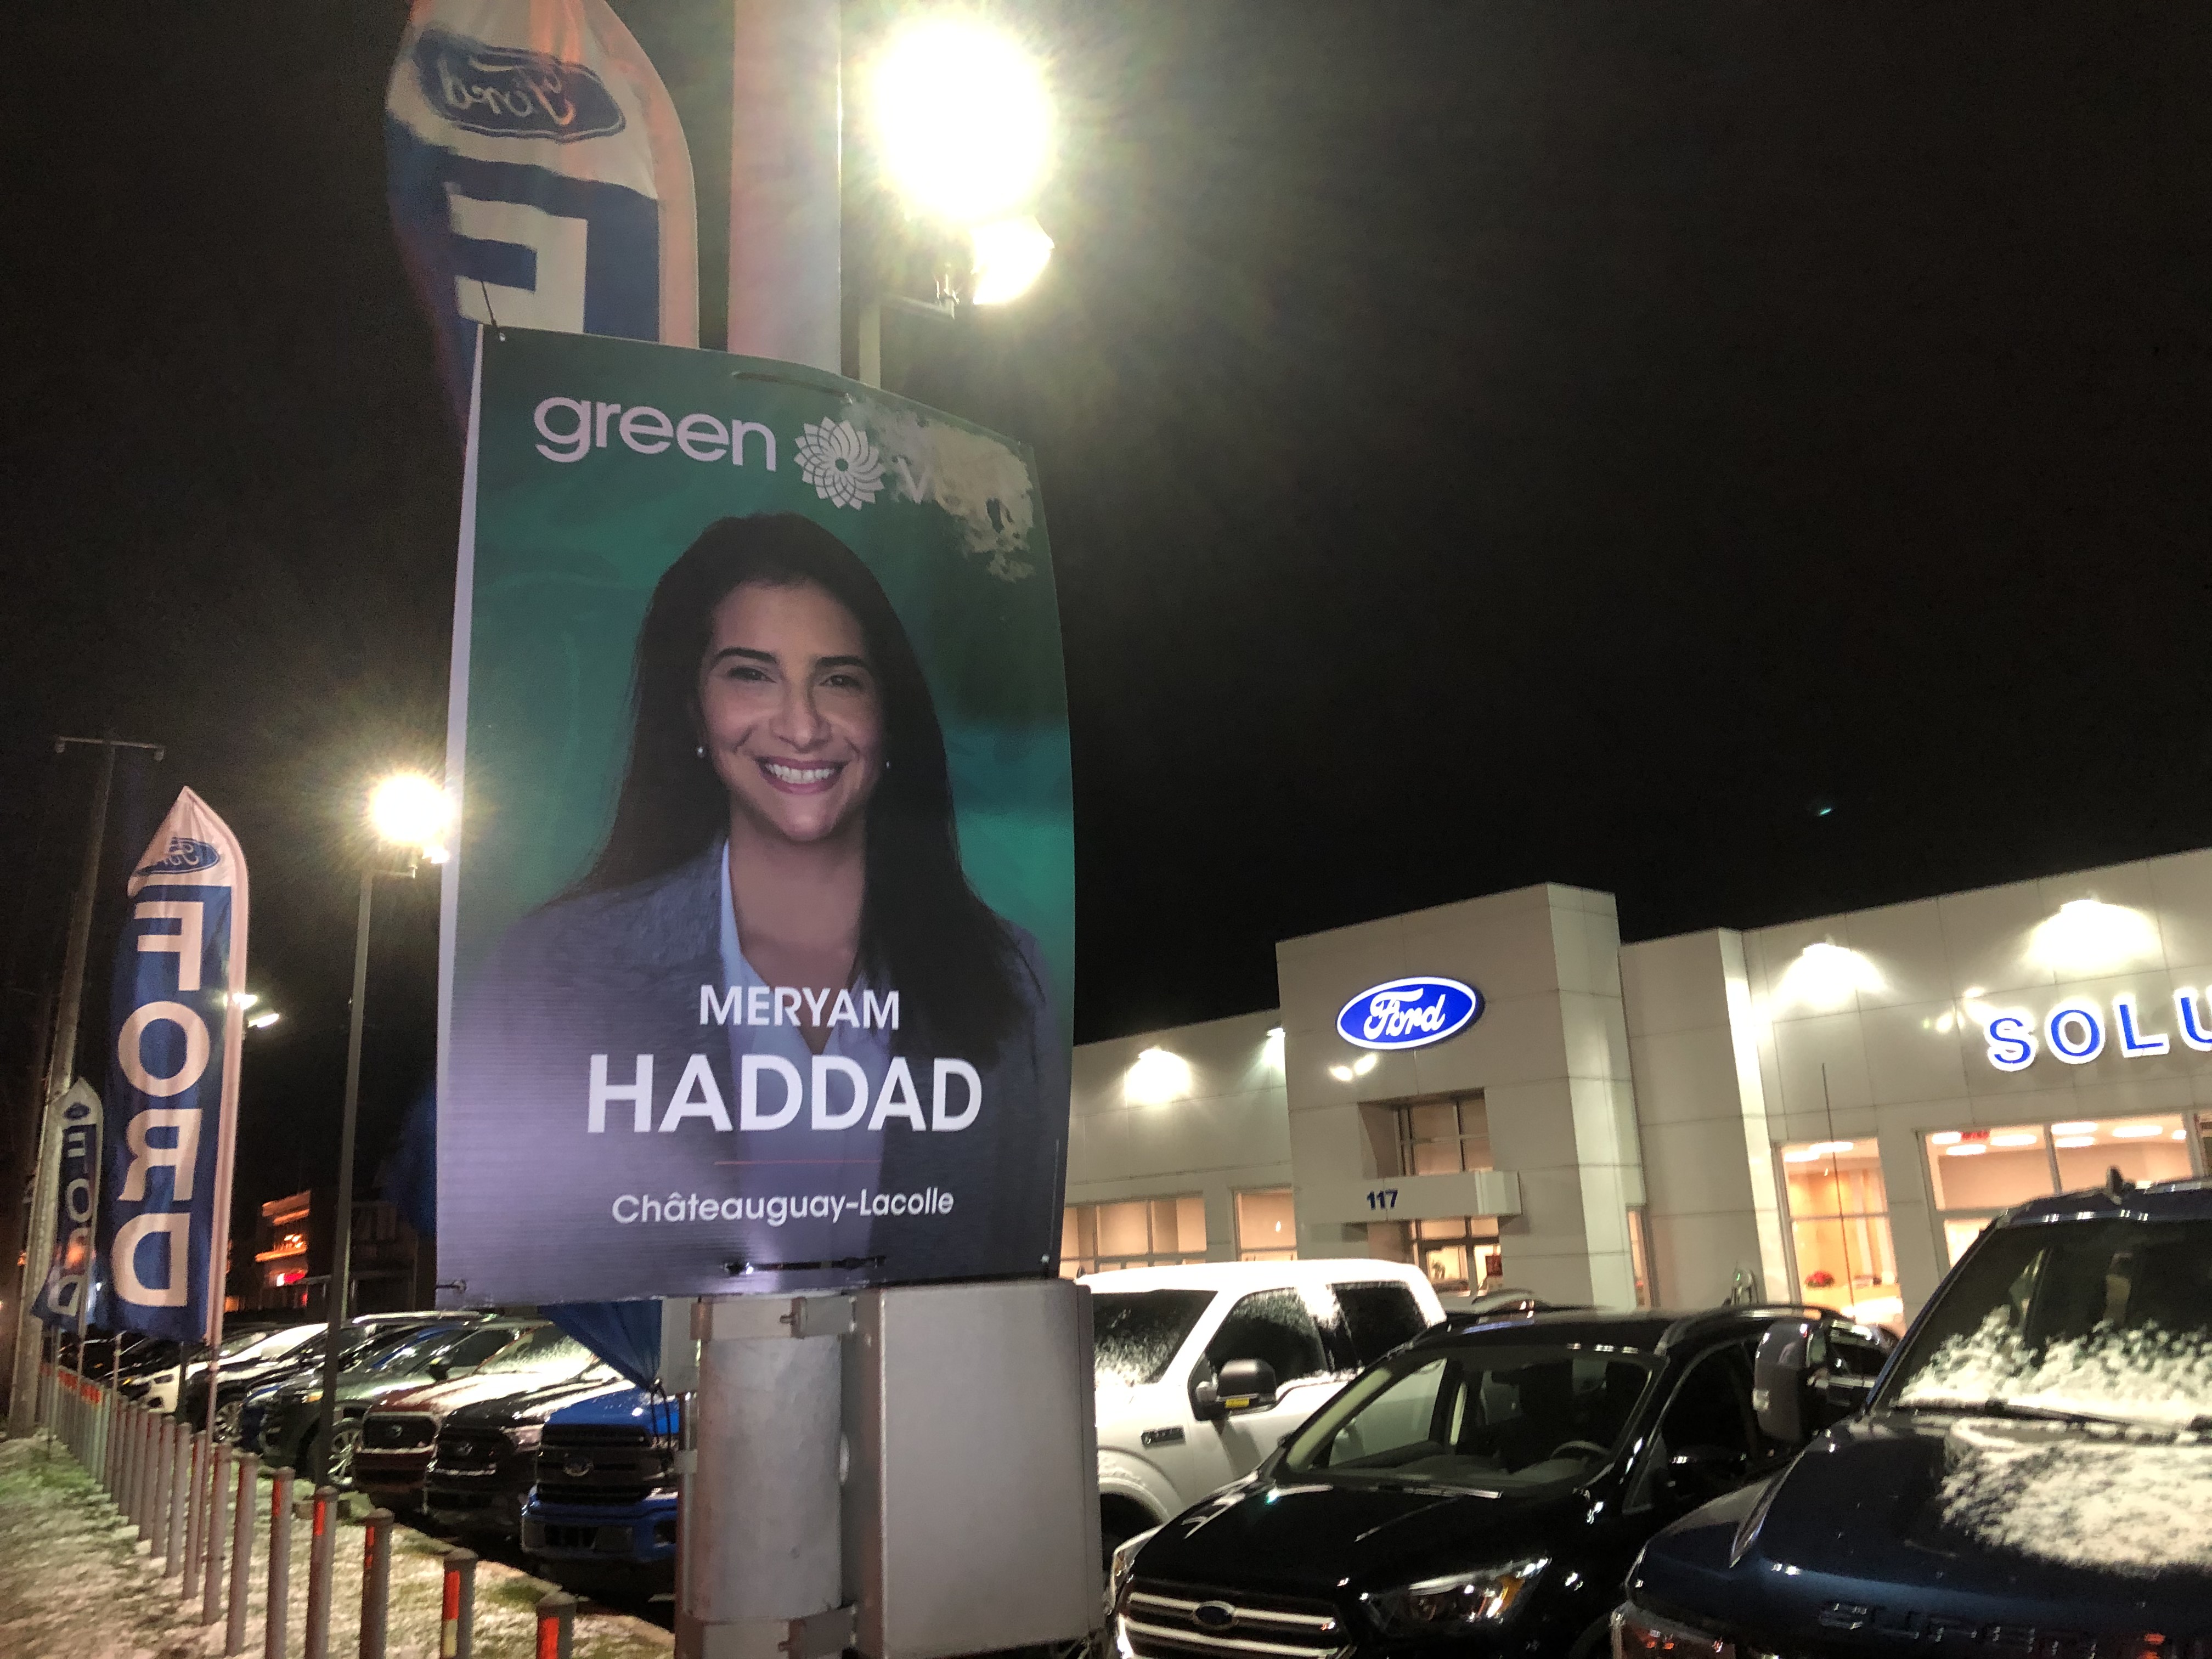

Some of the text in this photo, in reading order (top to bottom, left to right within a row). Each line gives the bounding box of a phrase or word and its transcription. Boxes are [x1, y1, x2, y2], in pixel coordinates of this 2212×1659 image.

[533, 396, 776, 473] green
[699, 984, 900, 1030] MERYAM
[1363, 988, 1446, 1040] Ford
[588, 1053, 983, 1134] HADDAD
[612, 1187, 955, 1227] Châteauguay-Lacolle
[1366, 1189, 1399, 1210] 117
